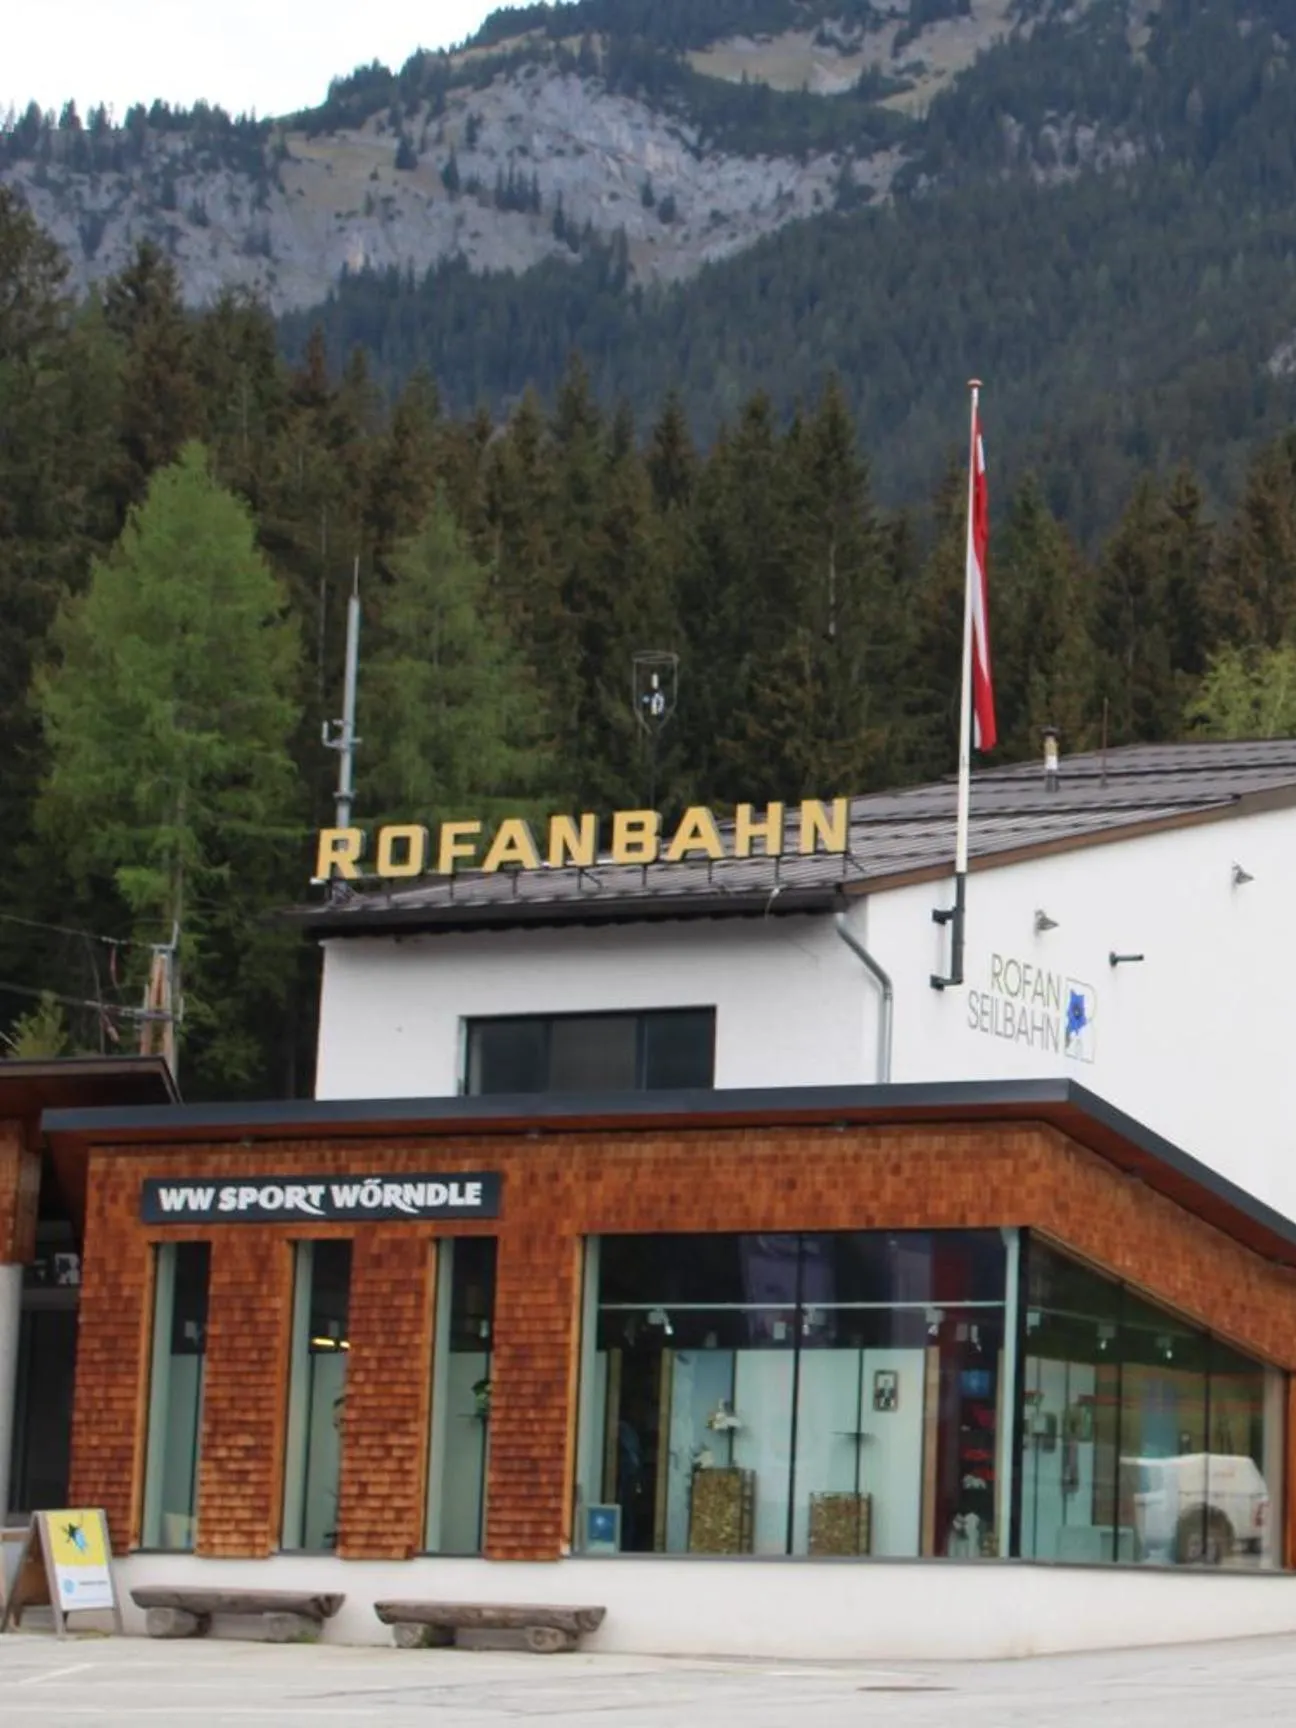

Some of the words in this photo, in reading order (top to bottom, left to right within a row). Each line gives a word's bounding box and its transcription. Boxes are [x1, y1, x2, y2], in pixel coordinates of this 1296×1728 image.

[314, 798, 849, 880] ROFANBAHN
[991, 953, 1061, 1010] ROFAN
[968, 989, 1060, 1053] SEILBAHN
[158, 1187, 215, 1212] WW
[218, 1184, 326, 1215] SPORT
[331, 1178, 482, 1214] WÖRNDLE
